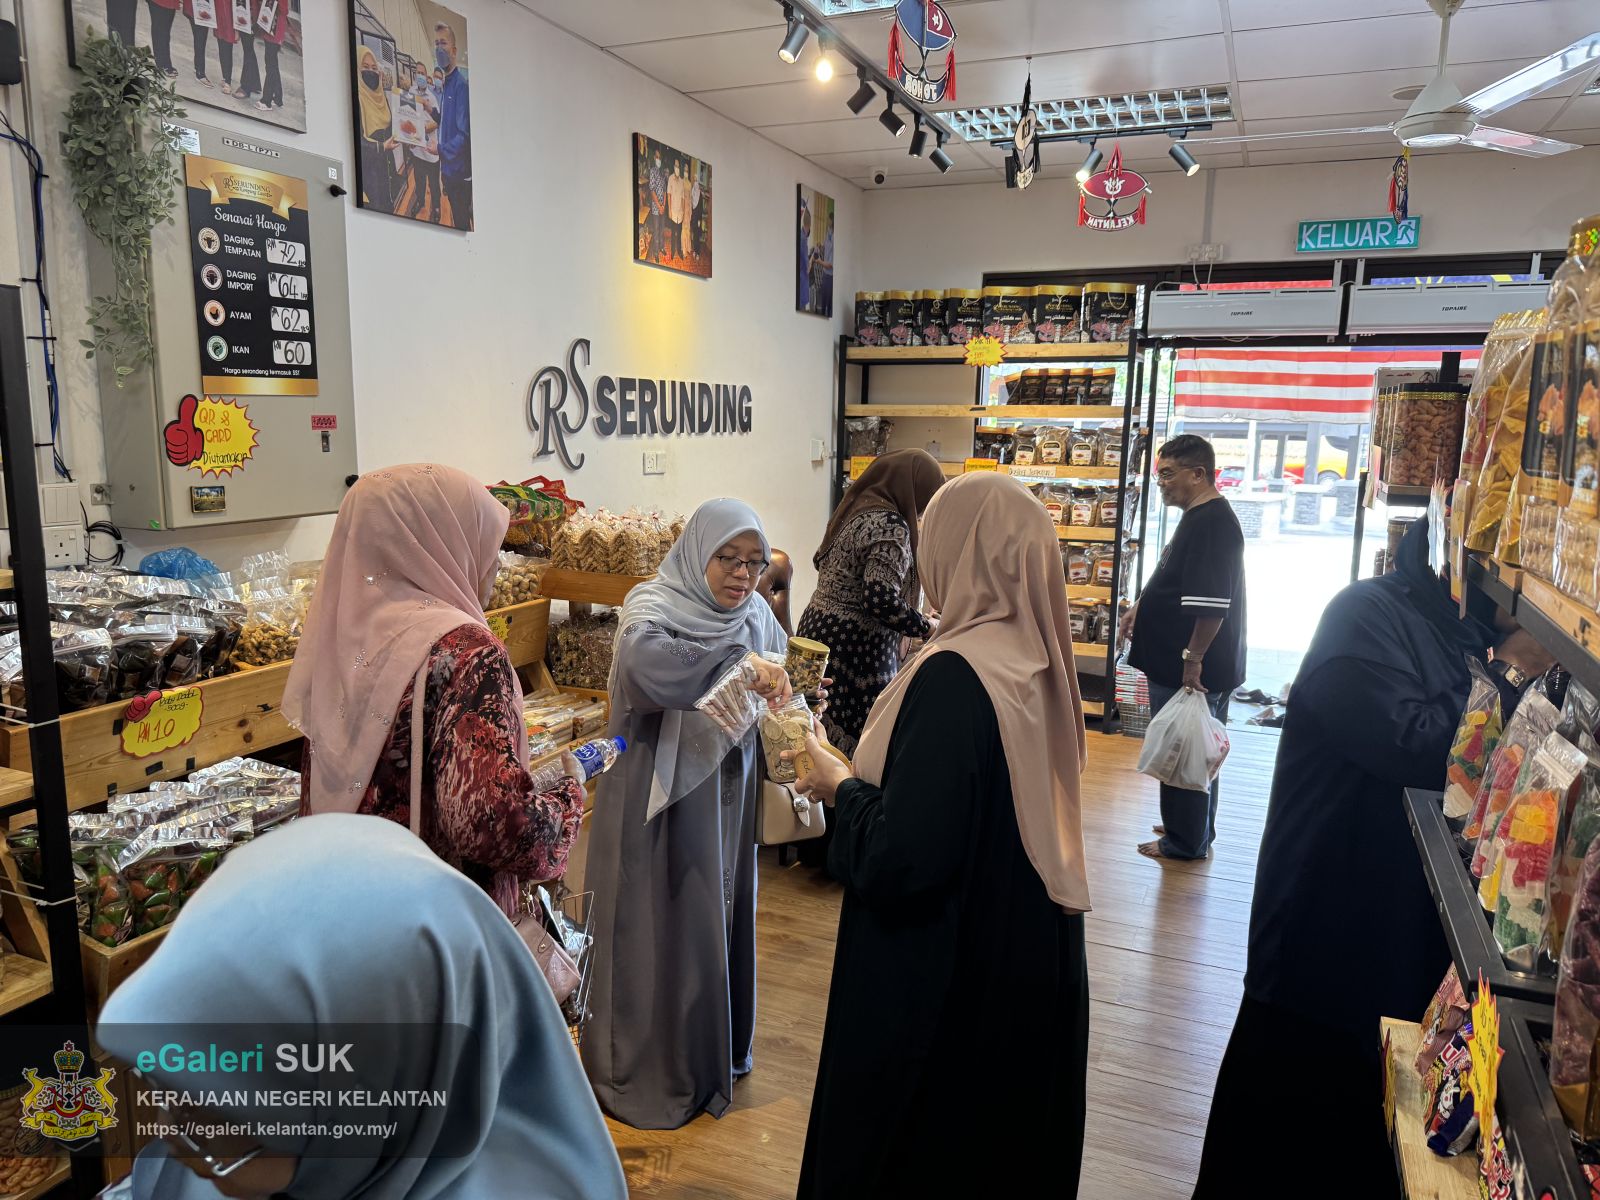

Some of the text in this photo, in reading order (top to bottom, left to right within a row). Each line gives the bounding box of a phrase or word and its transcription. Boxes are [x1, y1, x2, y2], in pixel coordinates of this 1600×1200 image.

[214, 206, 287, 237] Senarai Harga
[223, 233, 255, 246] DAGING
[1301, 221, 1393, 249] KELUAR
[225, 245, 261, 258] TEMPATAN
[279, 241, 298, 264] 72
[226, 269, 257, 281] DAGING
[227, 281, 254, 291] IMPORT
[278, 274, 299, 299] 64
[229, 311, 252, 320] AYAM
[281, 308, 301, 332] 62
[232, 345, 250, 354] IKAN
[284, 341, 305, 364] 60
[526, 338, 752, 471] RS SERUNDING
[199, 407, 215, 424] QR
[206, 428, 232, 443] CARD
[137, 718, 175, 743] RM 10
